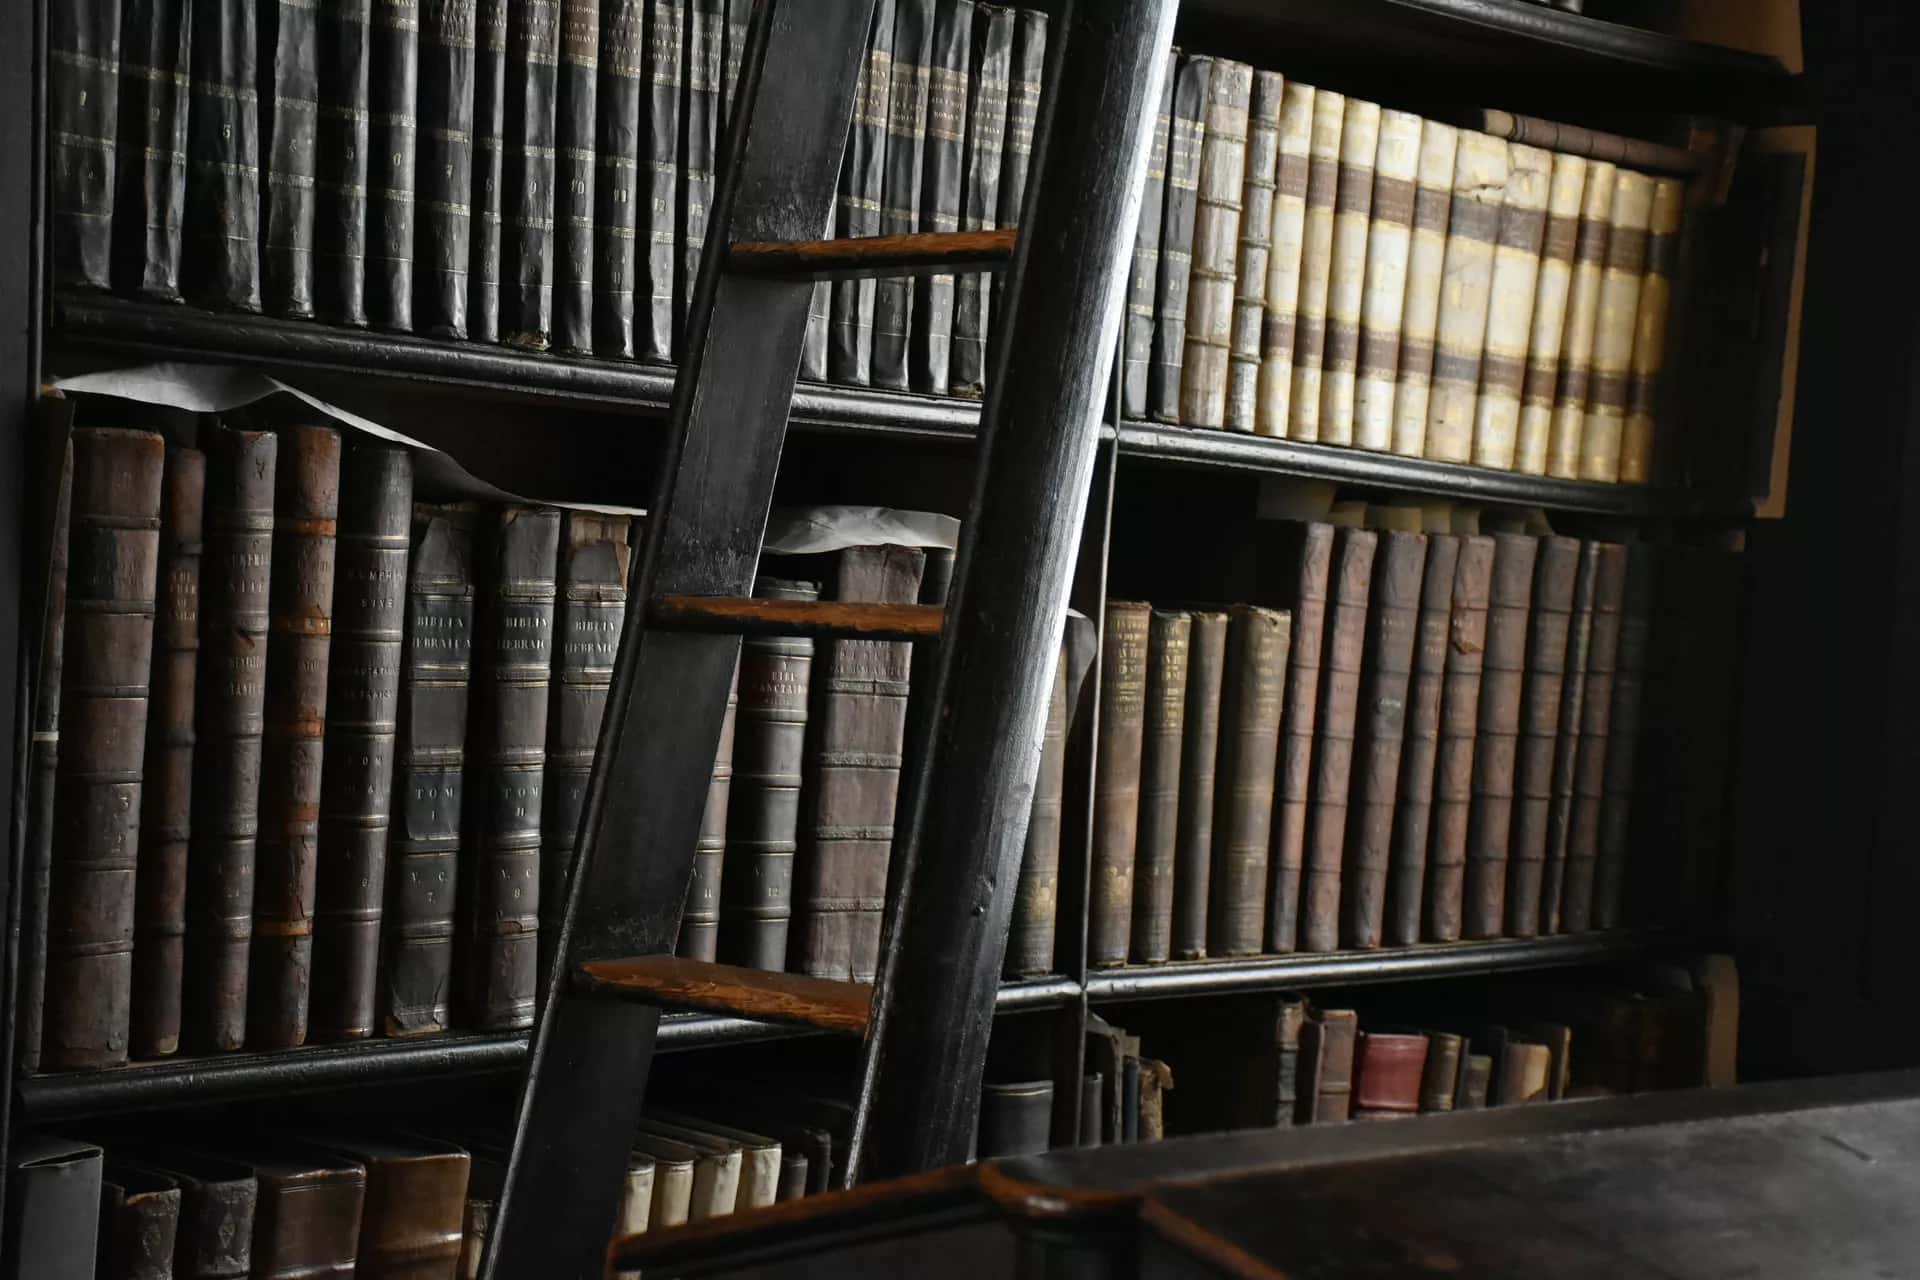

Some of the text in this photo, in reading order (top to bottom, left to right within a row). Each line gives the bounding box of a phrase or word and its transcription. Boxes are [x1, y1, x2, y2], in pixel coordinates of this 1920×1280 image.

[416, 616, 465, 629] BIBLIA
[505, 616, 549, 629] BIBLIA
[574, 620, 616, 632] BIBLIA
[499, 638, 546, 650] HEBRAIC
[563, 641, 614, 654] HEBRAIC
[415, 785, 455, 800] TOM
[503, 785, 539, 799] TOM
